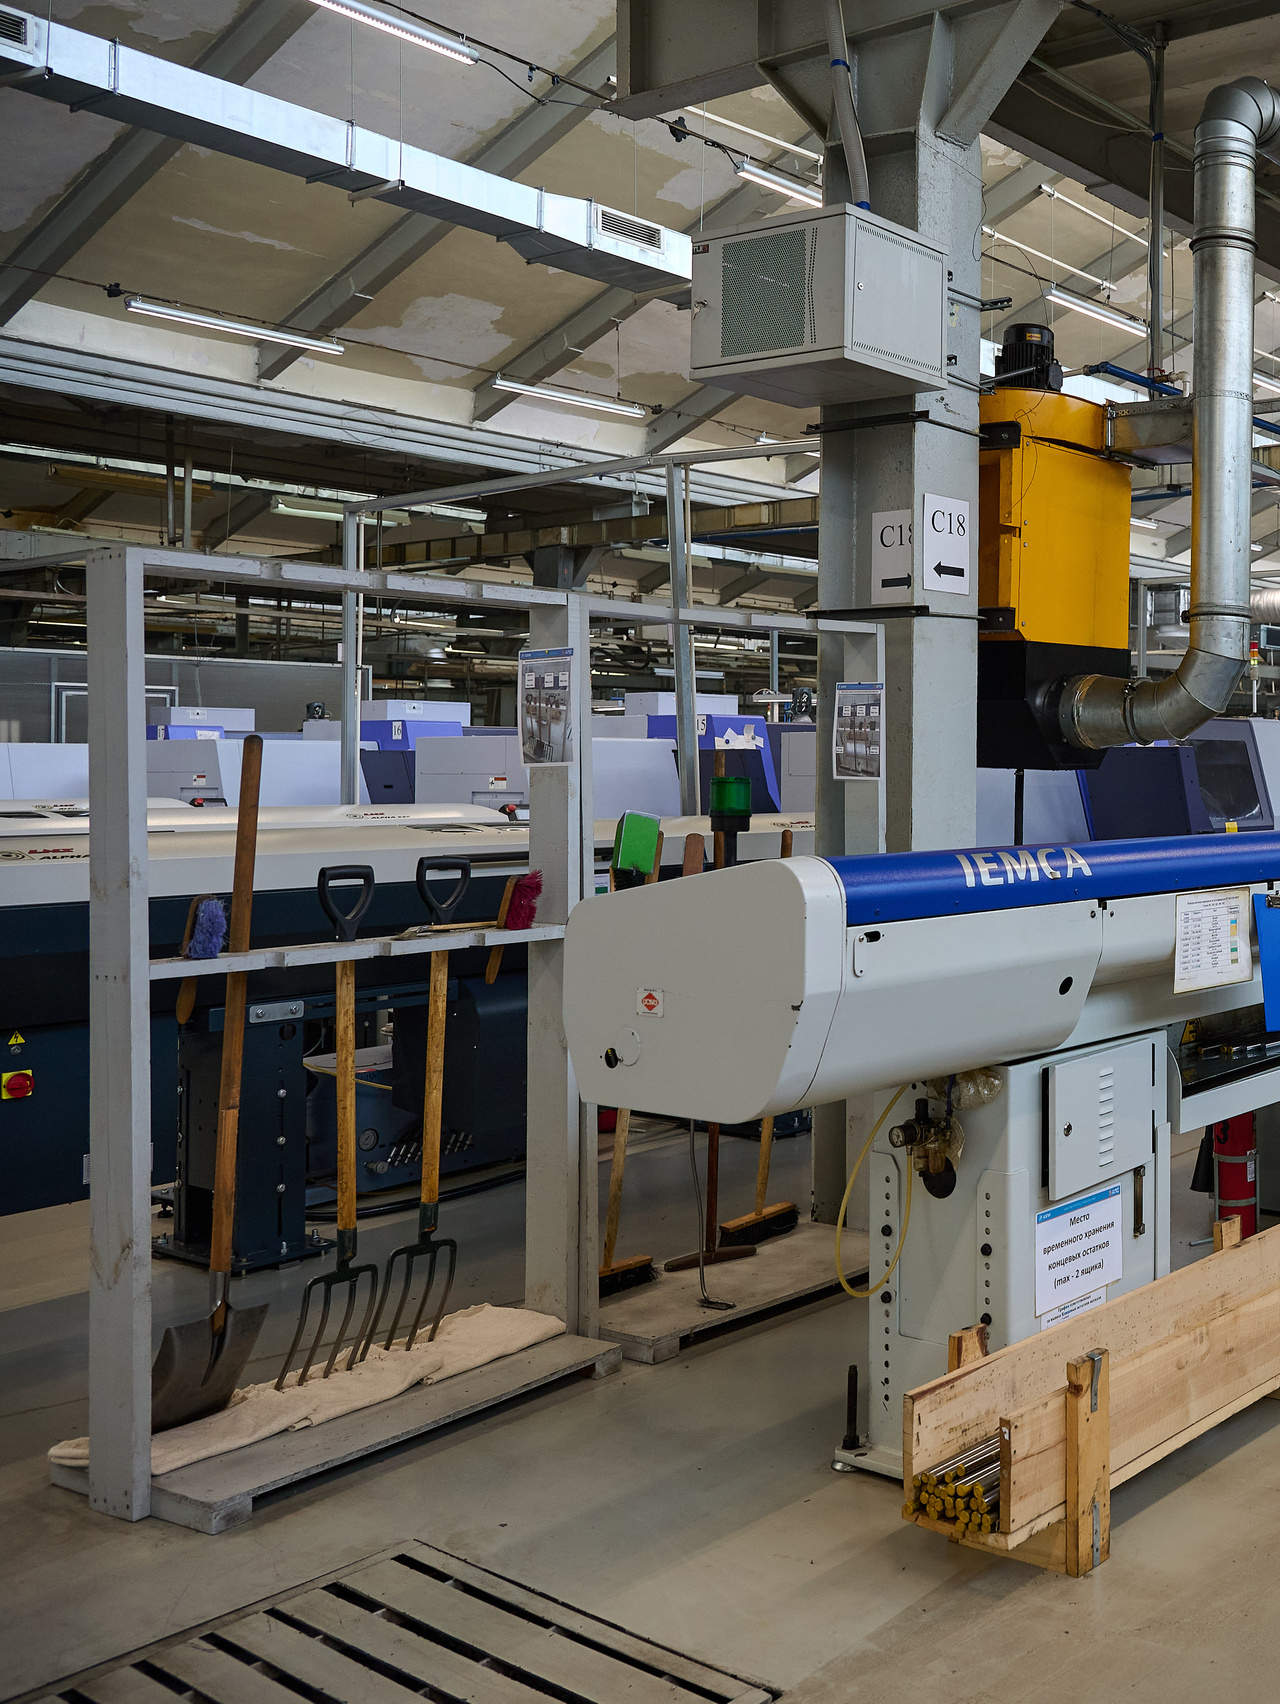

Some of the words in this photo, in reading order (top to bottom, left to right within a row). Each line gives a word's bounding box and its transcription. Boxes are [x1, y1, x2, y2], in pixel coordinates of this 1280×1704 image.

[931, 510, 966, 537] C18
[394, 725, 402, 736] 16
[697, 718, 706, 731] 15
[955, 847, 1093, 888] IEMCA
[1069, 1213, 1090, 1227] Место
[1042, 1233, 1084, 1256] временного
[1084, 1221, 1115, 1239] хранения
[1048, 1251, 1082, 1271] концевых
[1082, 1240, 1110, 1257] остатков
[1053, 1275, 1071, 1290] (max
[1075, 1269, 1080, 1279] 2
[1080, 1258, 1104, 1277] ящика)
